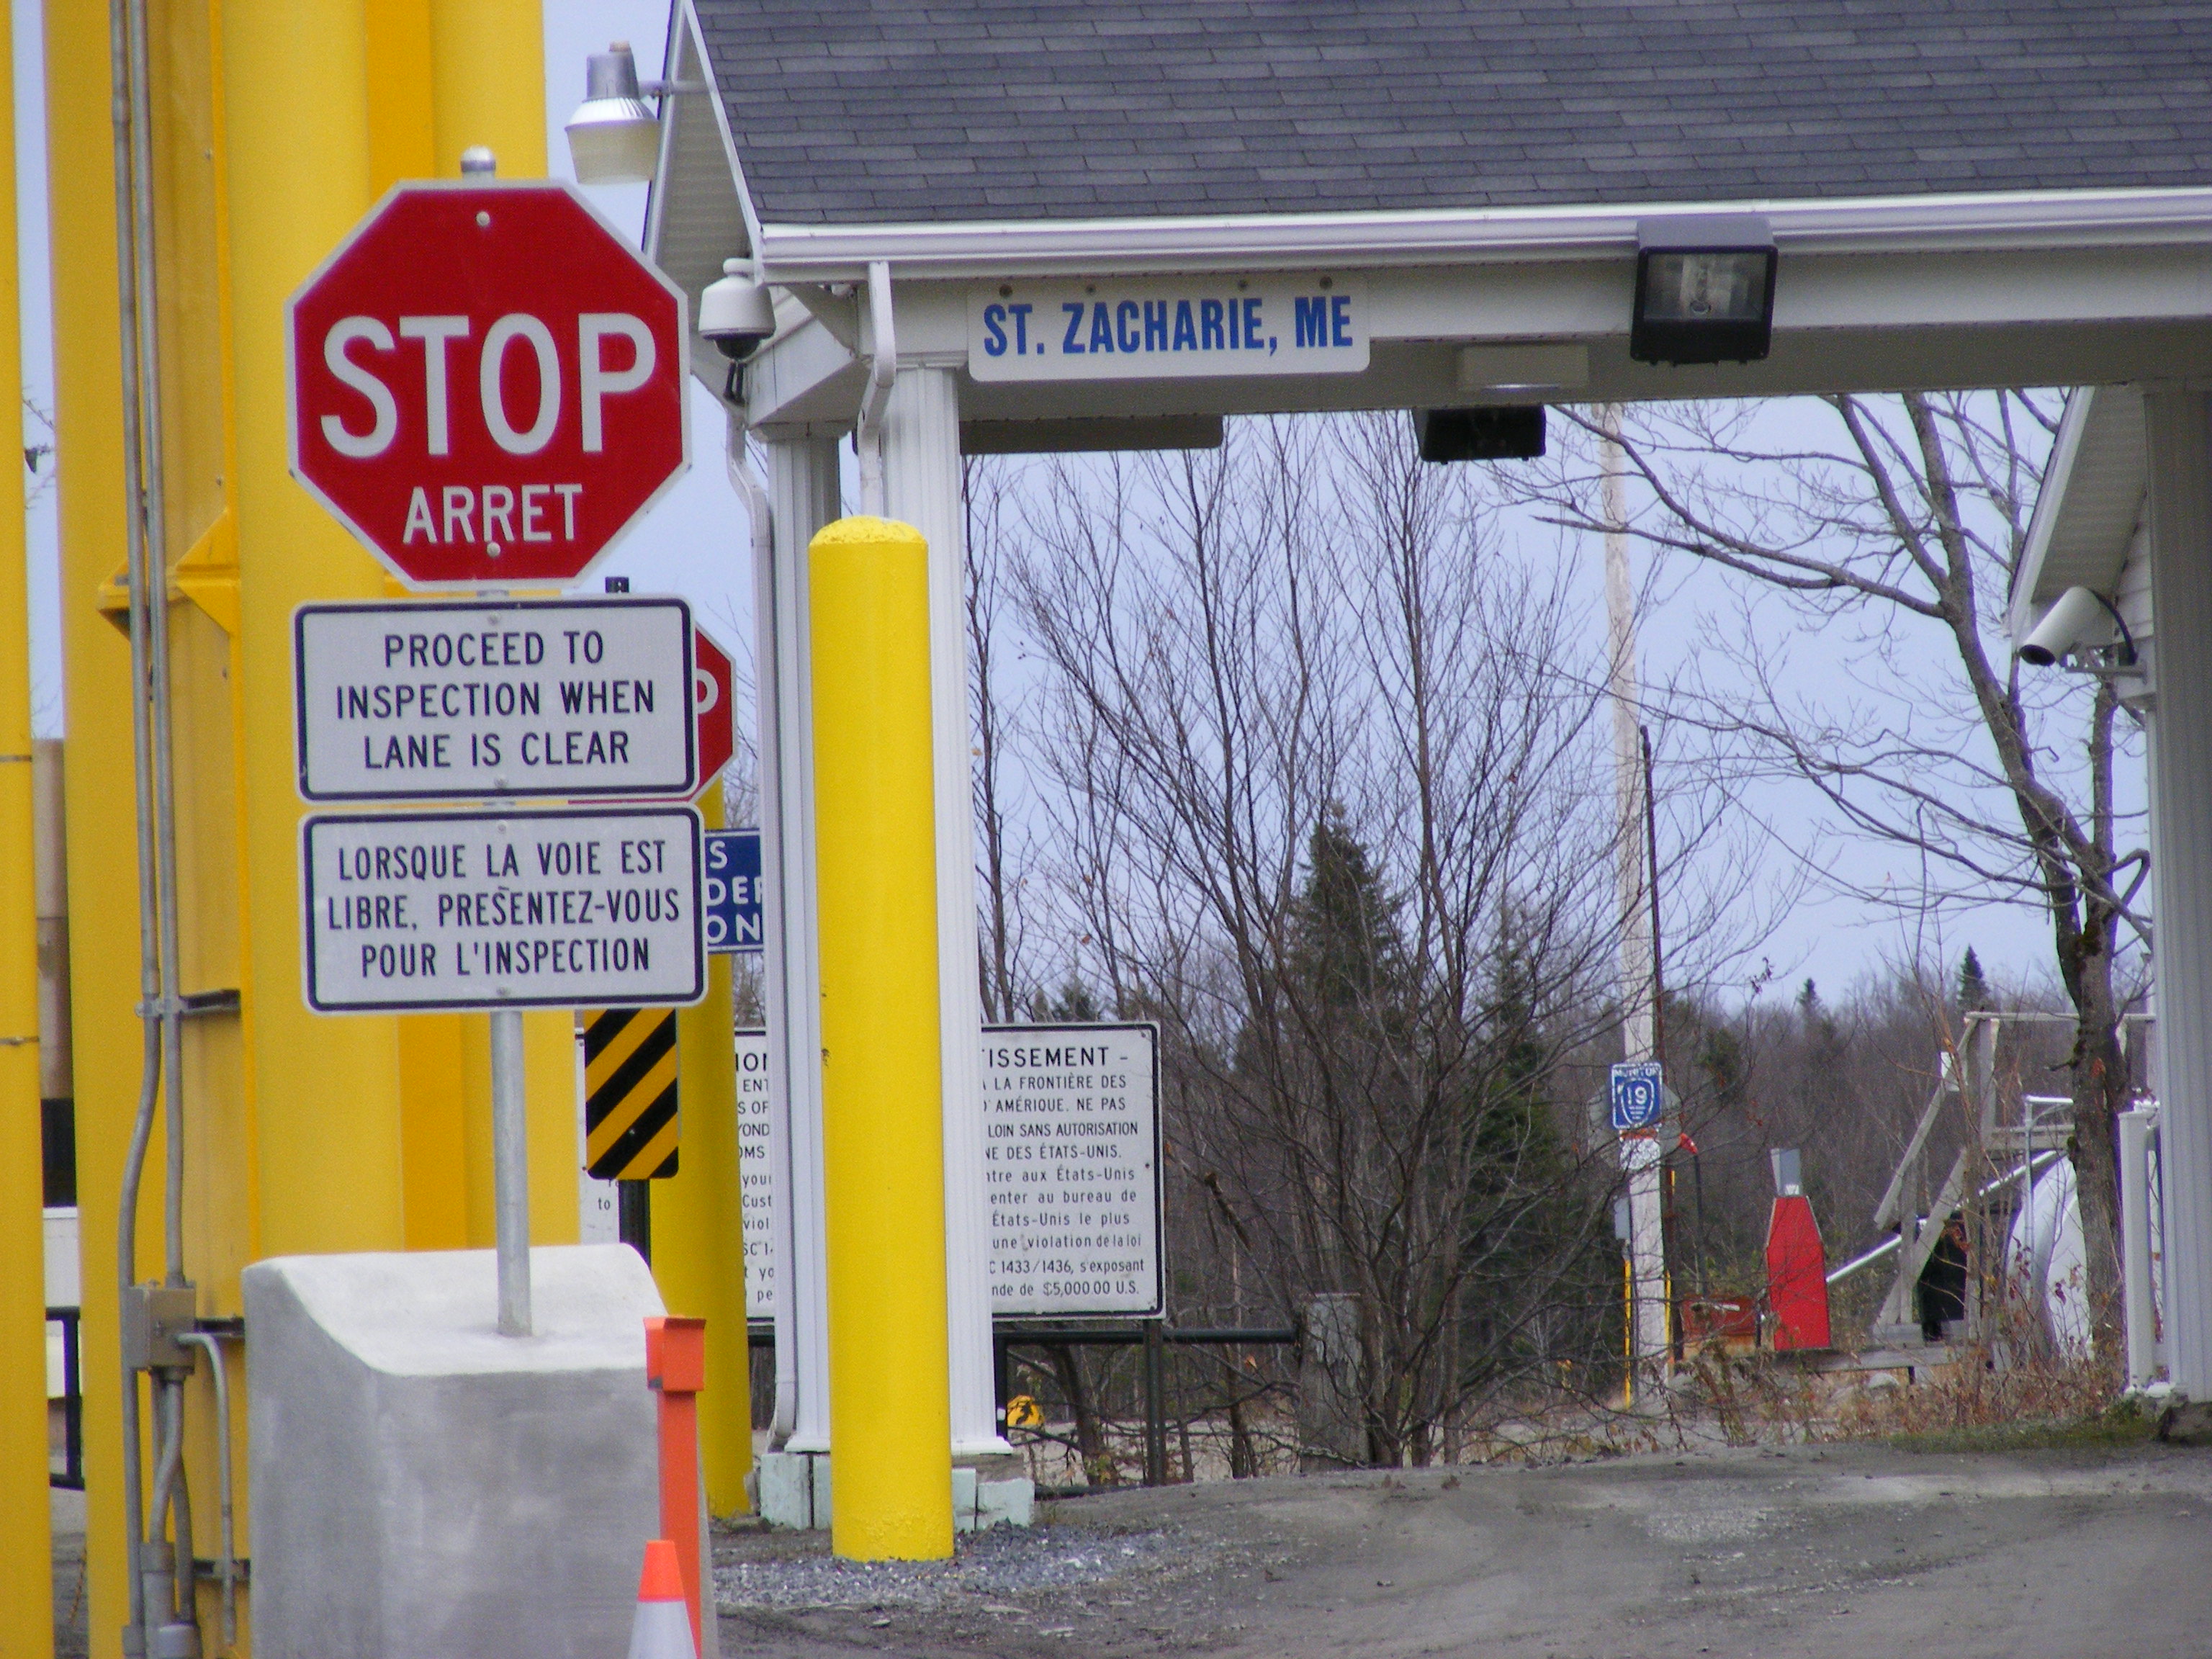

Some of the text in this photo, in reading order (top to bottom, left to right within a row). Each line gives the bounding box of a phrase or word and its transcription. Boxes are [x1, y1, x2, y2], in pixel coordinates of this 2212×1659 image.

[984, 295, 1353, 357] ST. ZACHARIE, ME
[320, 313, 656, 459] STOP
[403, 483, 583, 544] ARRET
[384, 630, 604, 668] PROCEED TO
[336, 679, 655, 720] INSPECTION WHEN
[364, 730, 629, 770] LANE IS CLEAR
[338, 840, 666, 881] LORSQUE LA VOIE EST
[328, 895, 418, 931] LIBRE,
[361, 937, 649, 979] POUR L'INSPECTION
[982, 1046, 1109, 1069] ISSEMENT
[994, 1076, 1012, 1091] LA
[1020, 1071, 1093, 1090] FRONTIÈRE
[1101, 1074, 1127, 1089] DES
[1076, 1097, 1093, 1112] NE
[1101, 1097, 1126, 1111] PAS
[1627, 1086, 1647, 1105] 19
[988, 1120, 1138, 1138] LOIN SANS AUTORISATION
[1007, 1146, 1032, 1160] DES
[1040, 1142, 1122, 1159] ÉTATS-UNIS.
[1022, 1170, 1047, 1182] aux
[1056, 1164, 1135, 1182] États-Unis
[1038, 1192, 1053, 1204] au
[1063, 1190, 1112, 1204] bureau
[1121, 1189, 1136, 1202] de
[992, 1210, 1130, 1228] États-Unis le plus
[992, 1237, 1017, 1250] une
[1028, 1233, 1092, 1249] violation
[1020, 1282, 1034, 1296] de
[1116, 1280, 1140, 1295] U.S.
